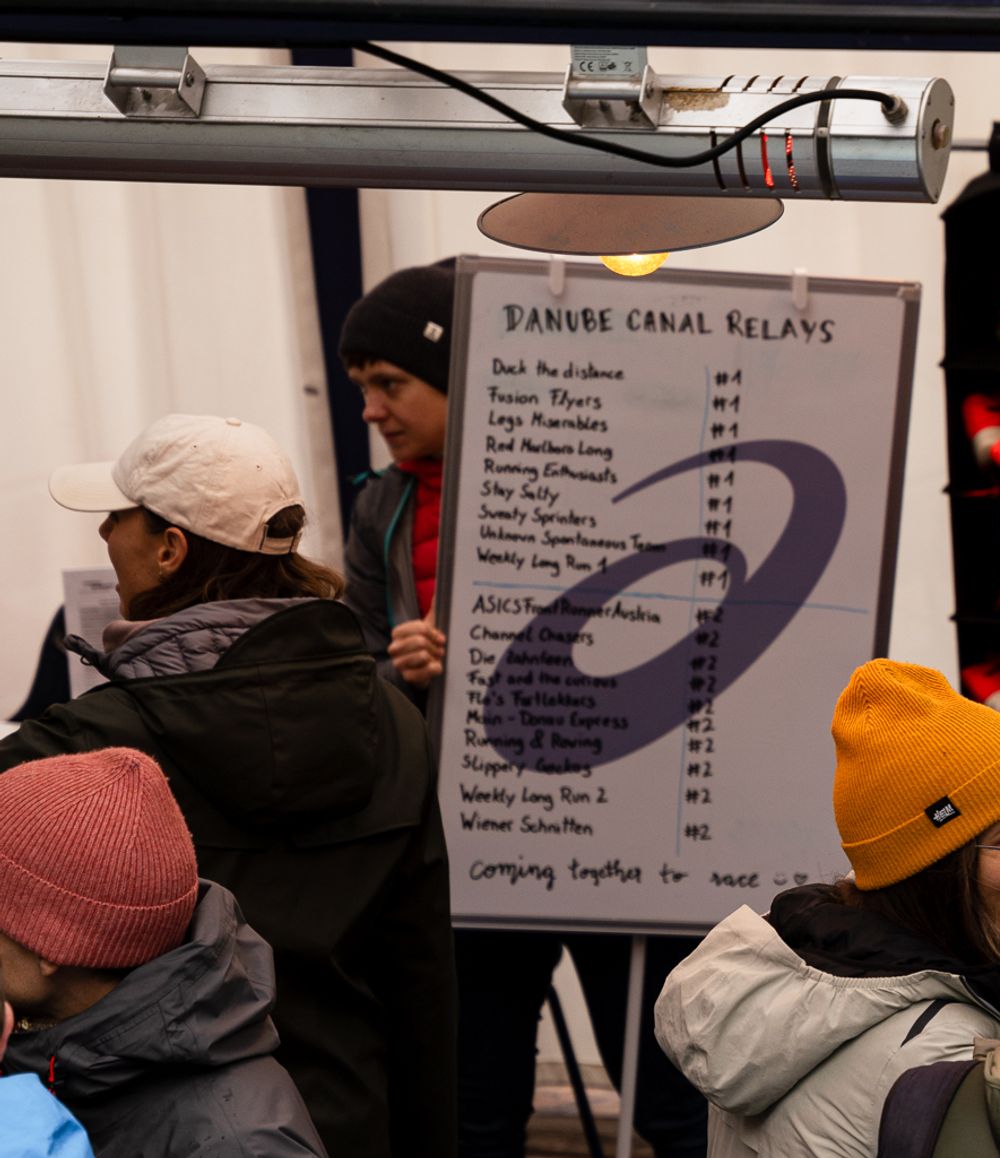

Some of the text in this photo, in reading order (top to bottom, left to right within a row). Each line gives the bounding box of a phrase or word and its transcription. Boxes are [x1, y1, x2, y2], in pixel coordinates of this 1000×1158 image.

[503, 304, 835, 343] DANUBE CANAL RELAYS
[492, 358, 741, 386] Duck the distance #1
[487, 386, 740, 413] Fusion Flyers #1
[488, 410, 738, 439] Legs Miserables #1
[486, 435, 514, 453] Red
[577, 441, 613, 461] Long
[708, 445, 736, 463] #1
[484, 458, 734, 489] Running Enthusiasts #1
[480, 480, 732, 514] Stay Salty #1
[478, 505, 732, 538] Sweaty Sprinters #1
[480, 525, 731, 561] Unknown Spontaneous Team #1
[477, 547, 728, 590] Weekly Long Run 1 #1
[696, 606, 724, 624] #2
[469, 625, 719, 648] Channel Chasers #2
[469, 648, 495, 665] Die
[690, 655, 717, 671] #2
[467, 671, 501, 687] Fast
[507, 671, 532, 685] and
[540, 672, 560, 685] the
[690, 676, 717, 692] #2
[688, 698, 714, 714] #2
[519, 710, 565, 726] Donau
[569, 711, 629, 730] Express
[686, 718, 715, 733] #2
[464, 729, 714, 755] Running & Rowing #2
[687, 760, 712, 778] #2
[460, 784, 712, 811] Weekly Long Run 2 #2
[460, 812, 712, 842] Wiener Schnitten #2
[568, 857, 642, 887] together
[659, 862, 688, 884] to
[710, 872, 760, 888] race
